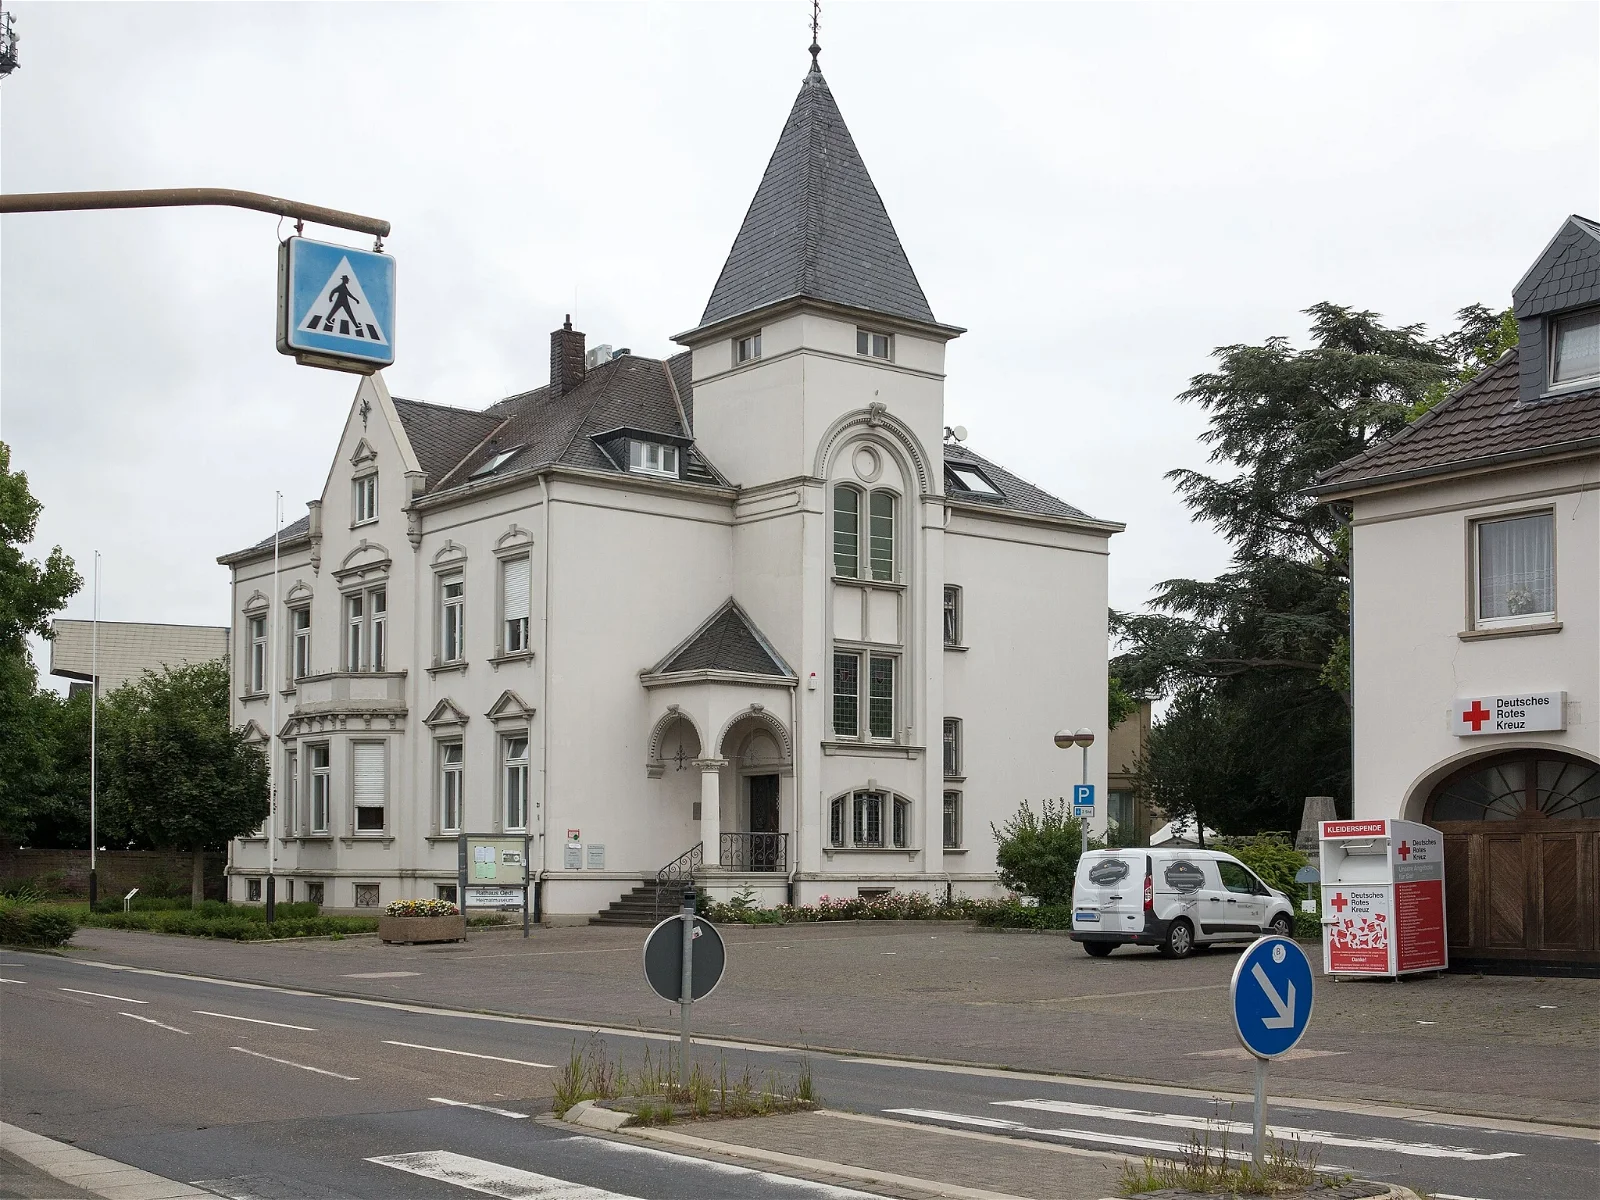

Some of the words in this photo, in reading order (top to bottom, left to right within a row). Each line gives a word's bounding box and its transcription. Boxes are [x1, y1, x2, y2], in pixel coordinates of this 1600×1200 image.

[1496, 697, 1550, 708] Deutsches
[1496, 709, 1526, 719] Rotes
[1496, 721, 1526, 730] Kreuz
[1078, 787, 1090, 803] P
[1327, 824, 1382, 834] KLEIDERSPENDE
[1412, 838, 1437, 846] Deutsches
